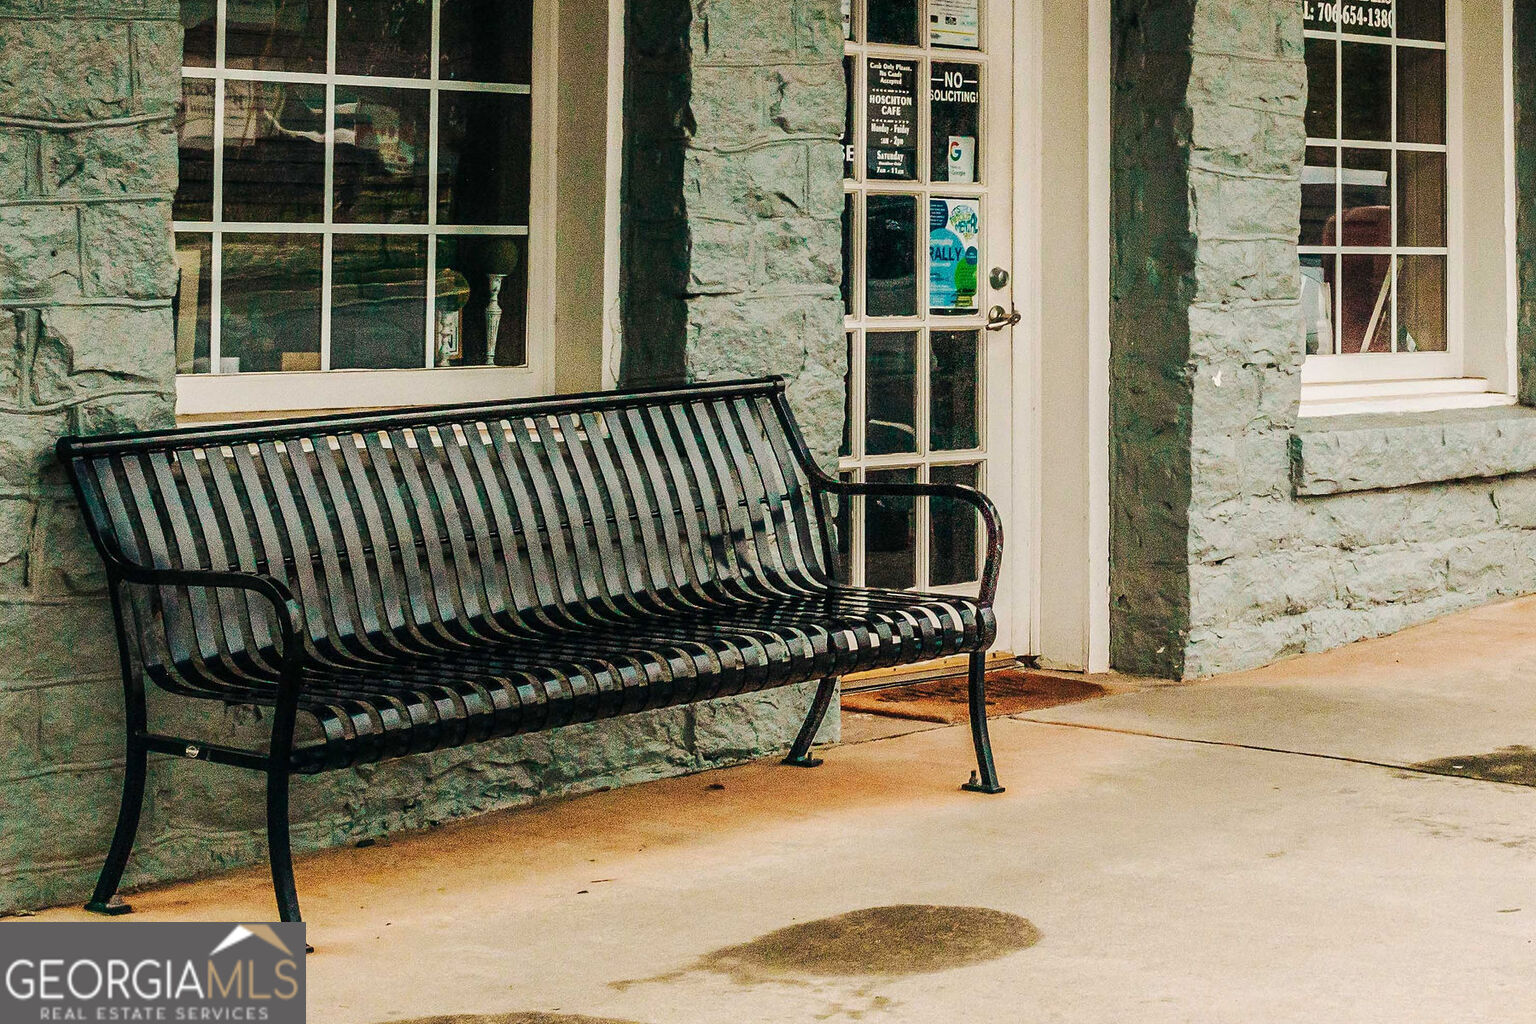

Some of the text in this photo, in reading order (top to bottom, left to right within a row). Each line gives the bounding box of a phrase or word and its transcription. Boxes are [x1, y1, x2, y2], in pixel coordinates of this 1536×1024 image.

[944, 71, 963, 88] NO
[869, 94, 912, 106] HOSCHTON
[931, 89, 979, 104] SOLICITING!
[881, 105, 901, 116] CAFE
